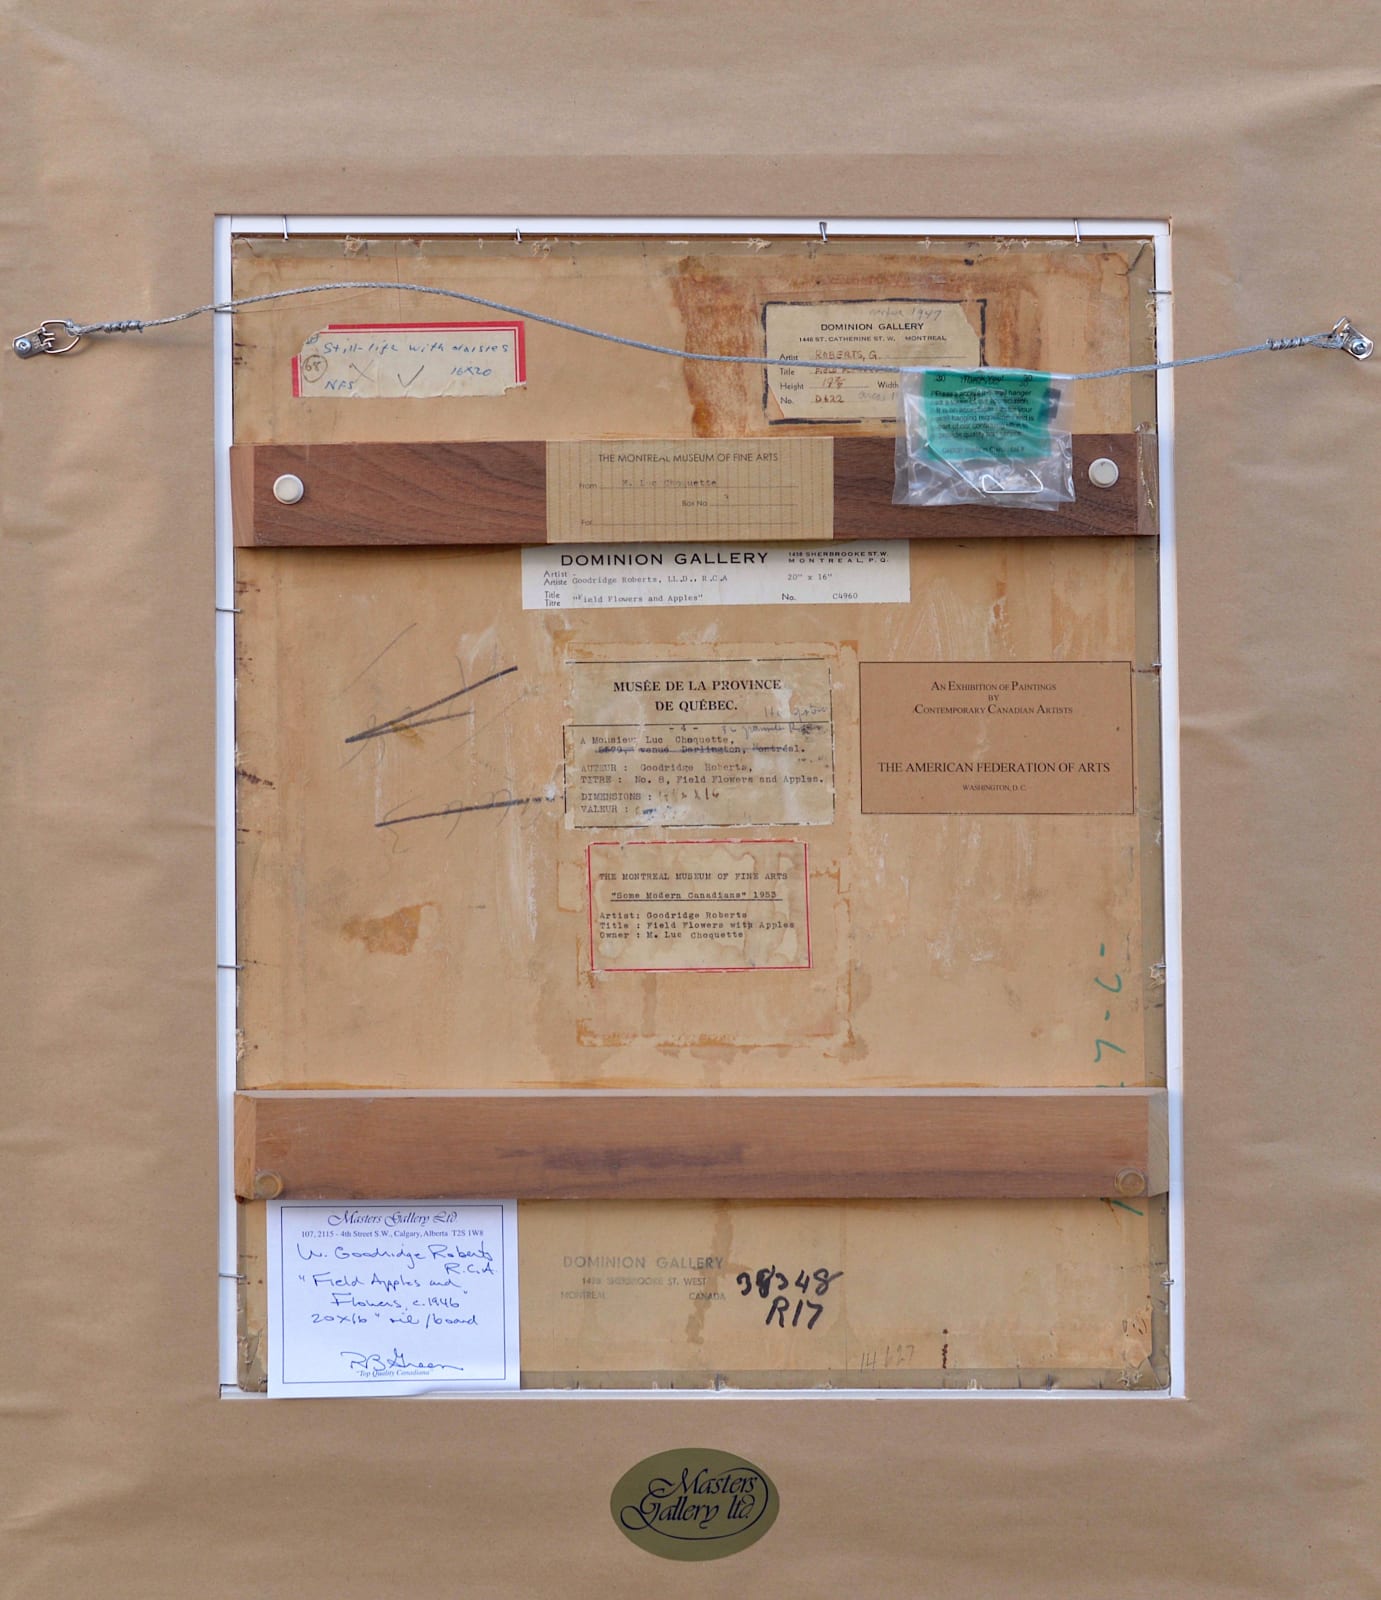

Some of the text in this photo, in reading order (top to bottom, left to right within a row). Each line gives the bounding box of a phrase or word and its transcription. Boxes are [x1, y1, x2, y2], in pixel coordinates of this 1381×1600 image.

[820, 322, 924, 331] DOMINION GALLERY
[409, 341, 444, 353] with
[780, 368, 796, 376] Title
[780, 382, 804, 391] Height
[598, 453, 778, 462] THE MONTREAL MUSEUM OF FINE ARTS
[561, 554, 663, 566] DOMINION
[674, 552, 768, 565] GALLERY
[543, 570, 568, 578] Artist
[543, 578, 568, 586] Artiste
[572, 576, 618, 586] Goodridge
[544, 590, 560, 598] Title
[608, 594, 644, 602] Flowers
[649, 594, 664, 602] and
[668, 594, 703, 603] Apples"
[544, 592, 858, 607] Titre No. C4960
[613, 678, 782, 692] MUSÉE DE LA PROVINCE
[988, 694, 1000, 702] BY
[655, 698, 738, 713] DE QUÉBEC.
[646, 736, 663, 744] Luc
[581, 764, 617, 772] AUTEUR
[640, 763, 694, 772] Goodridge
[878, 762, 1110, 773] THE AMERICAN FEDERATION OF ARTS
[581, 776, 612, 784] TITRE
[635, 776, 652, 784] No.
[676, 775, 706, 784] Field
[712, 776, 754, 784] Flowers
[760, 776, 777, 784] and
[962, 784, 1012, 792] WASHINGTON,
[581, 792, 642, 800] DIMENSIONS
[580, 805, 618, 813] VALEUR
[599, 872, 788, 880] THE MONTREAL MUSEUM OF FINE ARTS
[688, 891, 746, 899] Canadians"
[600, 911, 748, 920] Artist: Goodridge Roberts
[600, 921, 629, 929] Title
[759, 922, 795, 930] Apples
[690, 930, 744, 940] Choquette
[328, 1210, 458, 1227] Masters Gallery Ltd
[301, 1230, 317, 1239] 107,
[318, 1230, 334, 1238] 2115
[341, 1230, 352, 1238] 4th
[352, 1230, 373, 1238] Street
[394, 1230, 423, 1240] Calgary,
[424, 1230, 448, 1238] Alberta
[452, 1230, 466, 1238] T2S
[335, 1245, 426, 1269] Goodridge
[428, 1240, 494, 1261] Roberts
[563, 1256, 724, 1270] DOMINION GALLERY
[371, 1272, 461, 1292] Apples and
[684, 1276, 707, 1286] WEST
[688, 1292, 726, 1300] CANADA
[766, 1295, 824, 1330] R17
[372, 1370, 395, 1378] Quality
[648, 1467, 758, 1498] Masters
[621, 1490, 720, 1530] Gallery
